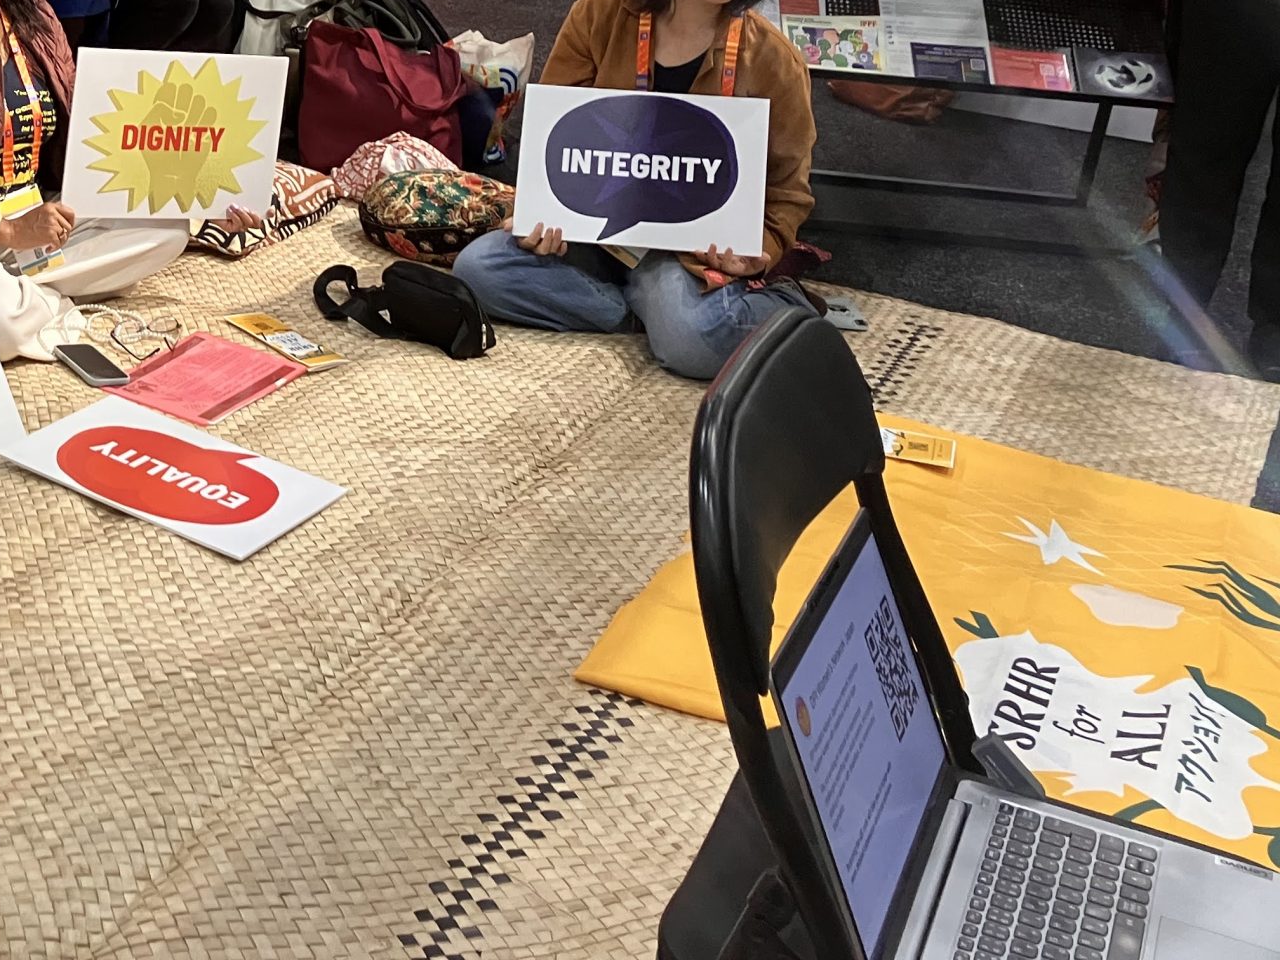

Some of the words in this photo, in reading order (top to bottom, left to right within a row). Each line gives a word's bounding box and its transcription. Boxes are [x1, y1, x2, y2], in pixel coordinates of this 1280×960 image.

[121, 124, 225, 152] DIGNITY
[561, 148, 722, 184] INTEGRITY
[89, 441, 250, 509] EQUALITY
[988, 657, 1060, 750] SRHR
[1052, 704, 1105, 744] for
[1110, 704, 1171, 770] ALL
[1175, 692, 1225, 802] アクション
